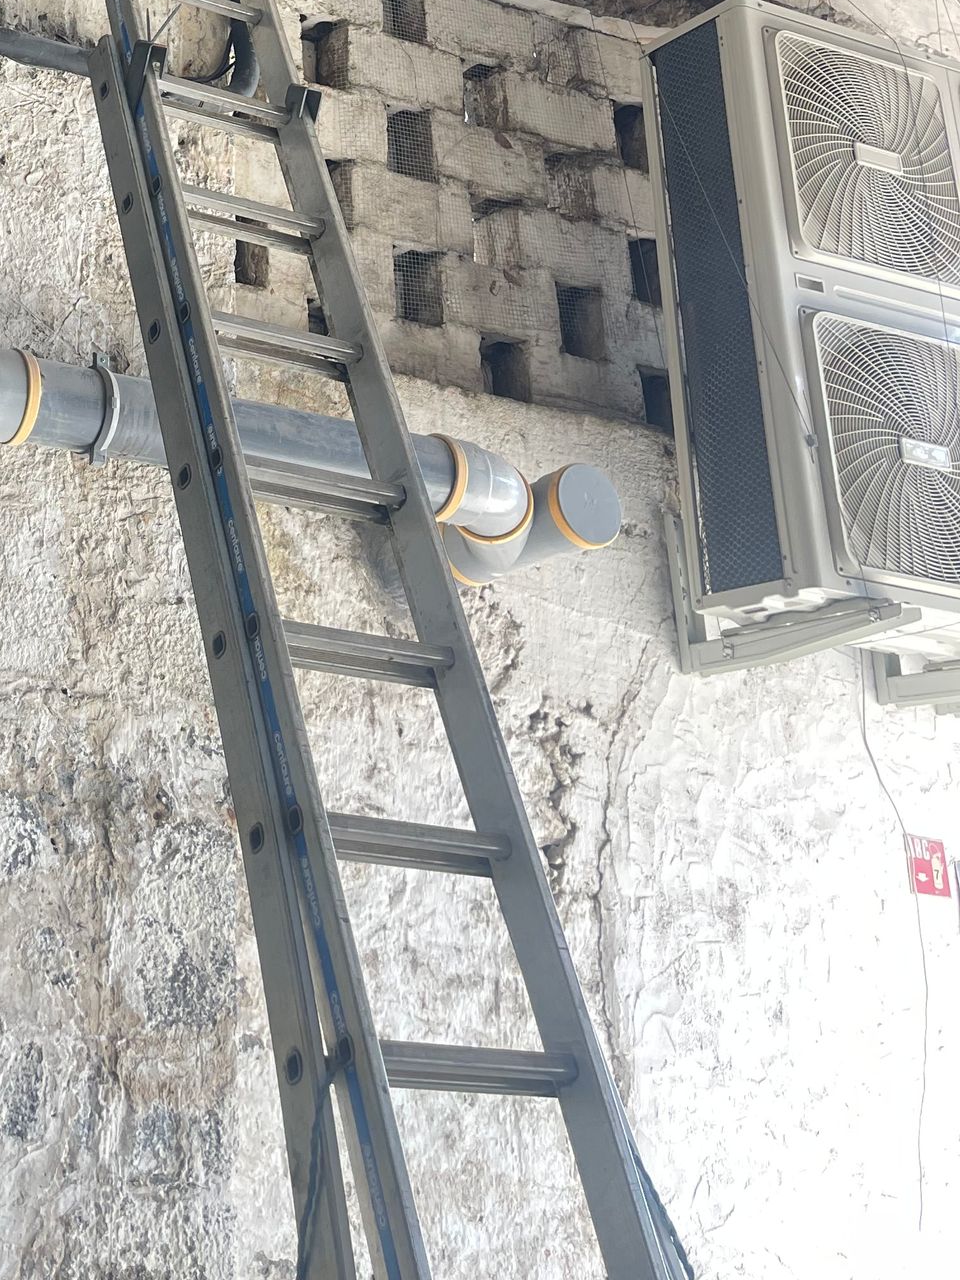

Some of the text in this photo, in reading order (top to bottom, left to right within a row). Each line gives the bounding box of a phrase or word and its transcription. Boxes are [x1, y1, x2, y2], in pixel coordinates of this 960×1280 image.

[188, 337, 203, 385] centaure
[227, 518, 244, 572] centaure
[273, 732, 293, 797] centaure
[300, 856, 322, 927] centaure
[361, 1142, 386, 1232] centaure
